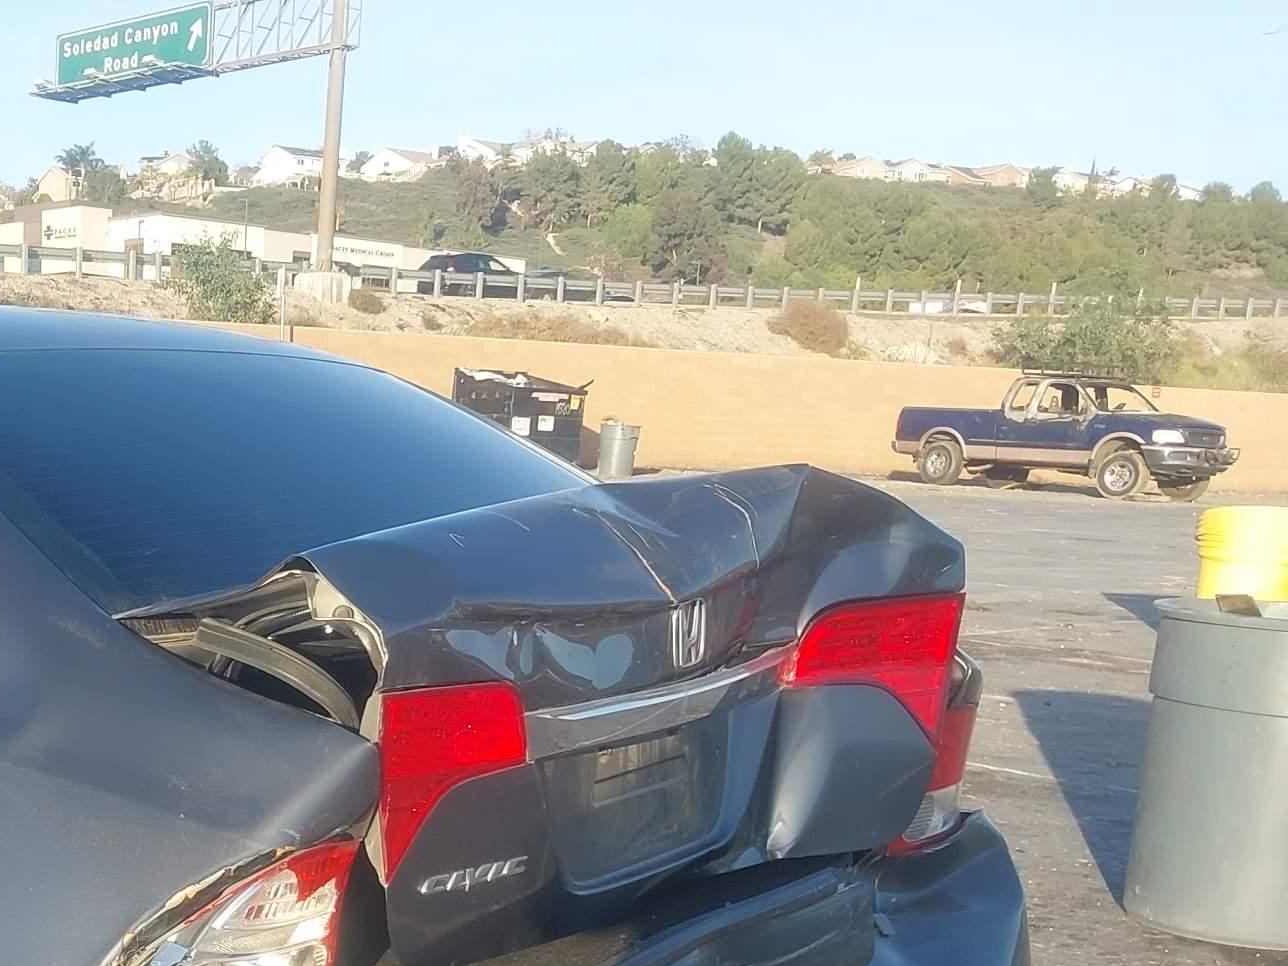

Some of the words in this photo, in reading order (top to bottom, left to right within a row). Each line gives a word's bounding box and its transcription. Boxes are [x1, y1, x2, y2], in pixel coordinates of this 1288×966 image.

[63, 31, 118, 58] Soledad
[124, 21, 178, 45] Canyon
[104, 51, 138, 73] Road
